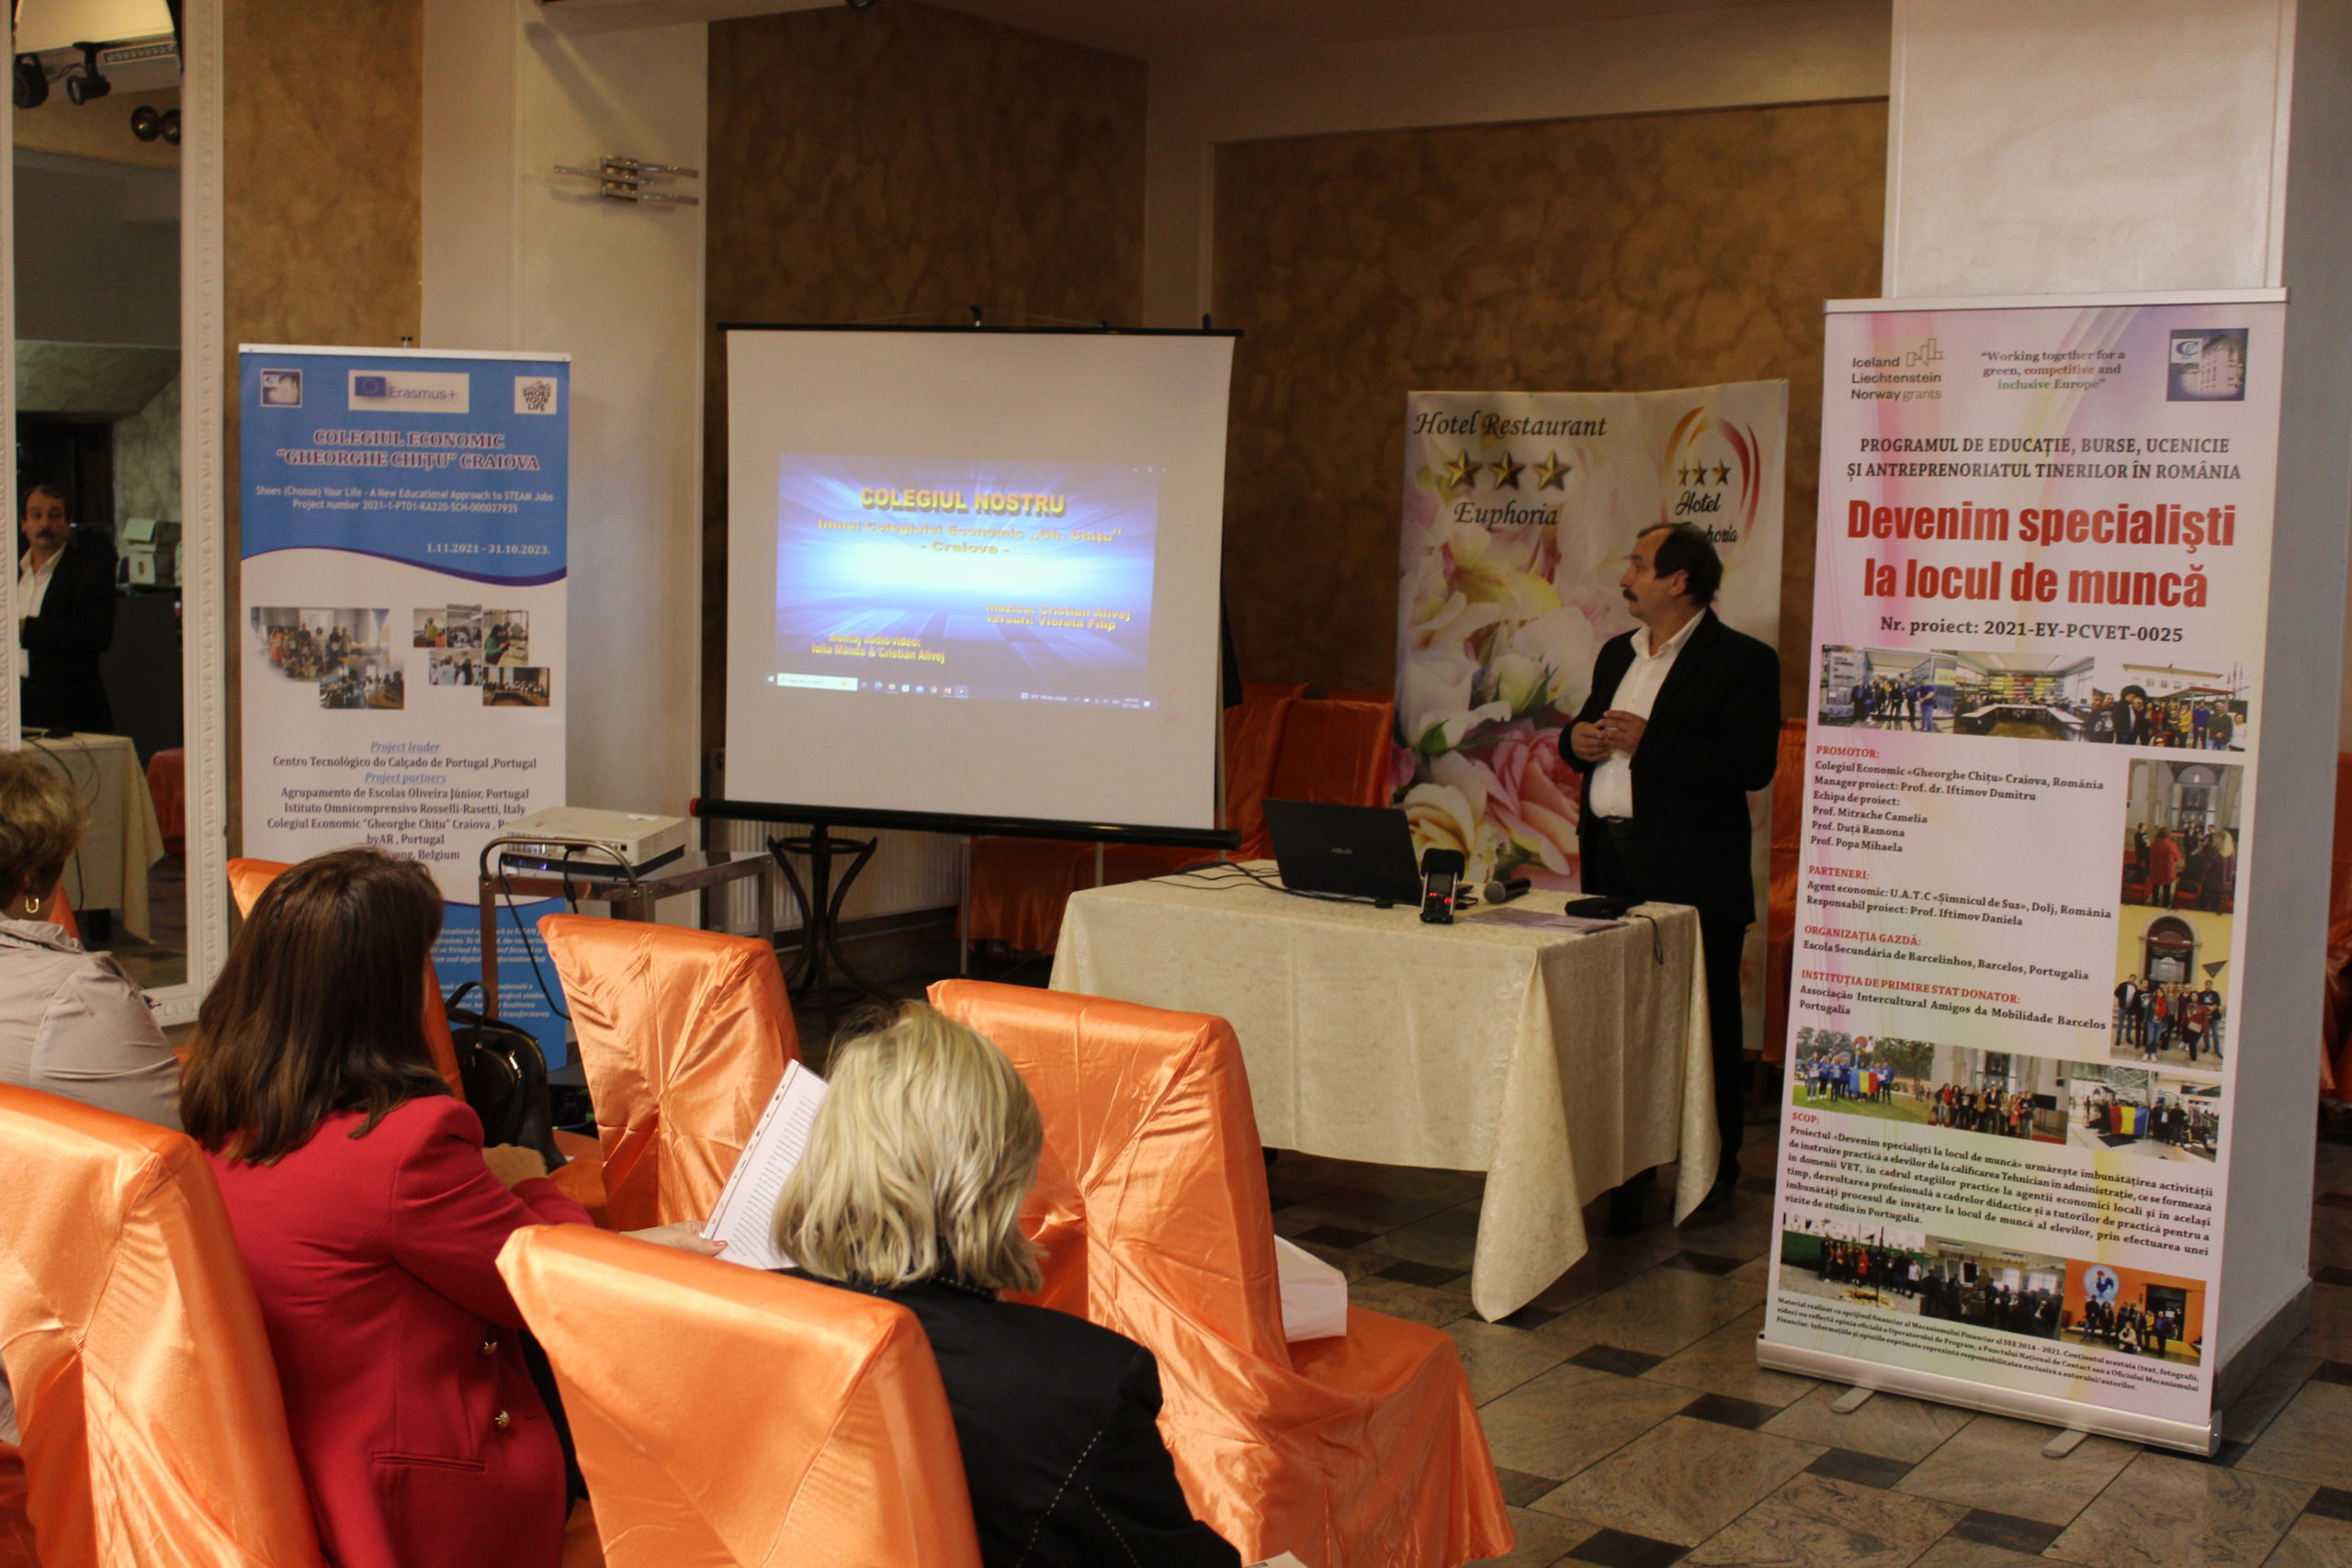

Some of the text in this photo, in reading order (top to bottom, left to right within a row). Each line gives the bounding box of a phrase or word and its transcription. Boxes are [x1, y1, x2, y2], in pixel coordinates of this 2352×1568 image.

[1852, 356, 1900, 367] Iceland
[2042, 350, 2094, 363] together
[2097, 350, 2113, 359] for
[1852, 372, 1941, 383] Liechtenstein
[1983, 365, 2120, 378] green, competitive and
[1997, 378, 2051, 389] inclusive
[389, 386, 457, 400] Erasmus+
[1851, 388, 1941, 401] Norway grants
[1414, 412, 1607, 436] Hotel Restaurant
[313, 429, 504, 449] COLEGIUL ECONOMIC
[1860, 438, 2228, 456] PROGRAMUL DE BURSE, UCENICIE
[459, 454, 540, 470] CRAIOVA
[1866, 461, 2241, 479] ANTREPRENORIATUL TINERILOR ÎN ROMÂNIA
[255, 485, 281, 496] Shoes
[323, 487, 342, 497] Your
[345, 487, 362, 497] Life
[378, 489, 396, 498] New
[399, 488, 448, 499] Educational
[450, 490, 490, 502] Approach
[492, 491, 502, 501] to
[504, 491, 532, 501] STEAM
[535, 491, 553, 502] Jobs
[860, 487, 1066, 516] COLEGIUL NOSTRU
[293, 499, 360, 511] Project number
[1676, 491, 1721, 516] Hotel
[1453, 500, 1558, 530] Euphoria
[1848, 500, 2008, 541] Devenim
[946, 525, 1023, 537] Economic
[931, 541, 998, 554] Craiova
[1863, 558, 2208, 607] la locul de muncă
[1881, 616, 2183, 642] Nr. proiect: 2021-EY-PCVET-0025
[370, 742, 441, 753] Project leader
[1816, 745, 1880, 759] PROMOTOR:
[273, 756, 488, 770] Centro Tecnológico do Calçado de Portugal
[365, 772, 447, 785] Project partners
[1815, 761, 2104, 790] Colegiul Economic Craiova, România
[280, 787, 351, 799] Agrupamento
[354, 788, 366, 797] de
[368, 788, 405, 798] Escolas
[408, 788, 447, 798] Oliveira
[486, 788, 529, 800] Portugal
[1815, 775, 2036, 801] Manager proiect: Prof. dr. Iftimov Dumitru
[1813, 791, 1900, 807] Echipa de proiect:
[284, 803, 526, 817] Istituto Omnicomprensivo Italy
[1813, 806, 1928, 824] Prof. Mitrache Camelia
[267, 818, 309, 830] Colegiul
[311, 818, 359, 829] Economic
[452, 819, 489, 830] Craiova
[1812, 820, 1905, 838] Prof. Ramona
[401, 835, 444, 847] Portugal
[1811, 835, 1903, 853] Prof. Popa Mihaela
[418, 850, 459, 862] Belgium
[1808, 864, 1870, 880] PARTENERI:
[1807, 880, 2111, 919] Agent economic: U.A.T.C de Dolj, România
[1807, 895, 2023, 926] Responsabil proiect: Prof. Iftimov Daniela
[1804, 940, 2089, 981] Escola Secundária de Barcelinhos, Barcelos, Portugalia
[1865, 976, 2021, 1004] DE PRIMIRE STAT DONATOR:
[1799, 999, 1850, 1016] Portugalia
[1800, 985, 2107, 1031] Associação Intercultural Amigos da Mobilidade Barcelos
[1792, 1111, 1820, 1124] SCOP:
[1790, 1125, 1983, 1161] Proiectul la locul de
[1801, 1141, 1926, 1168] instruire elevilor
[1800, 1156, 1911, 1179] domenii VET, cadrul
[1841, 1190, 1883, 1204] procesul
[2056, 1196, 2143, 1215] economici locali
[1825, 1200, 1855, 1213] studiu
[1869, 1207, 1923, 1224] Portugalia.
[2053, 1209, 2200, 1240] tutorilor pentru
[2123, 1234, 2209, 1256] efectuarea unei
